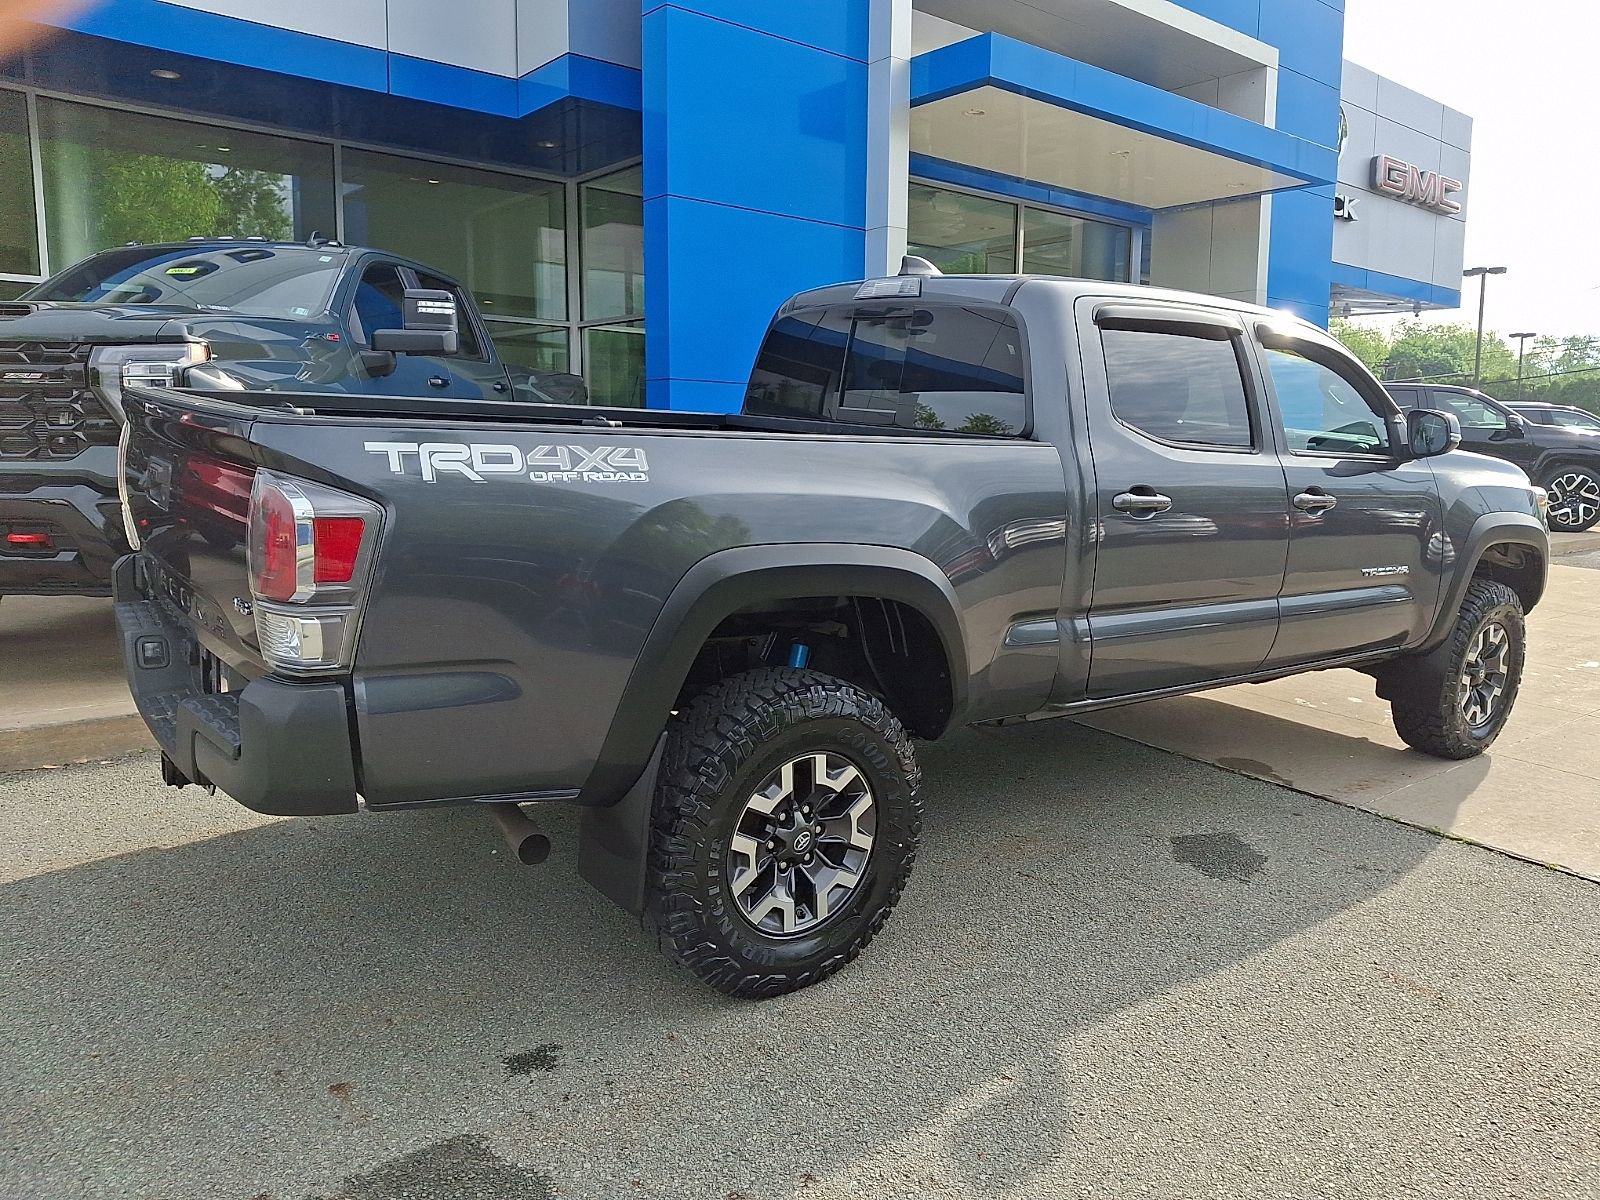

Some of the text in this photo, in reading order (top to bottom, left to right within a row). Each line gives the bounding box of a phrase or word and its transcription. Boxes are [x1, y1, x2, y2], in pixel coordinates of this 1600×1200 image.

[1371, 154, 1463, 215] GMC
[364, 442, 527, 483] TRD
[529, 471, 649, 482] OFF ROAD
